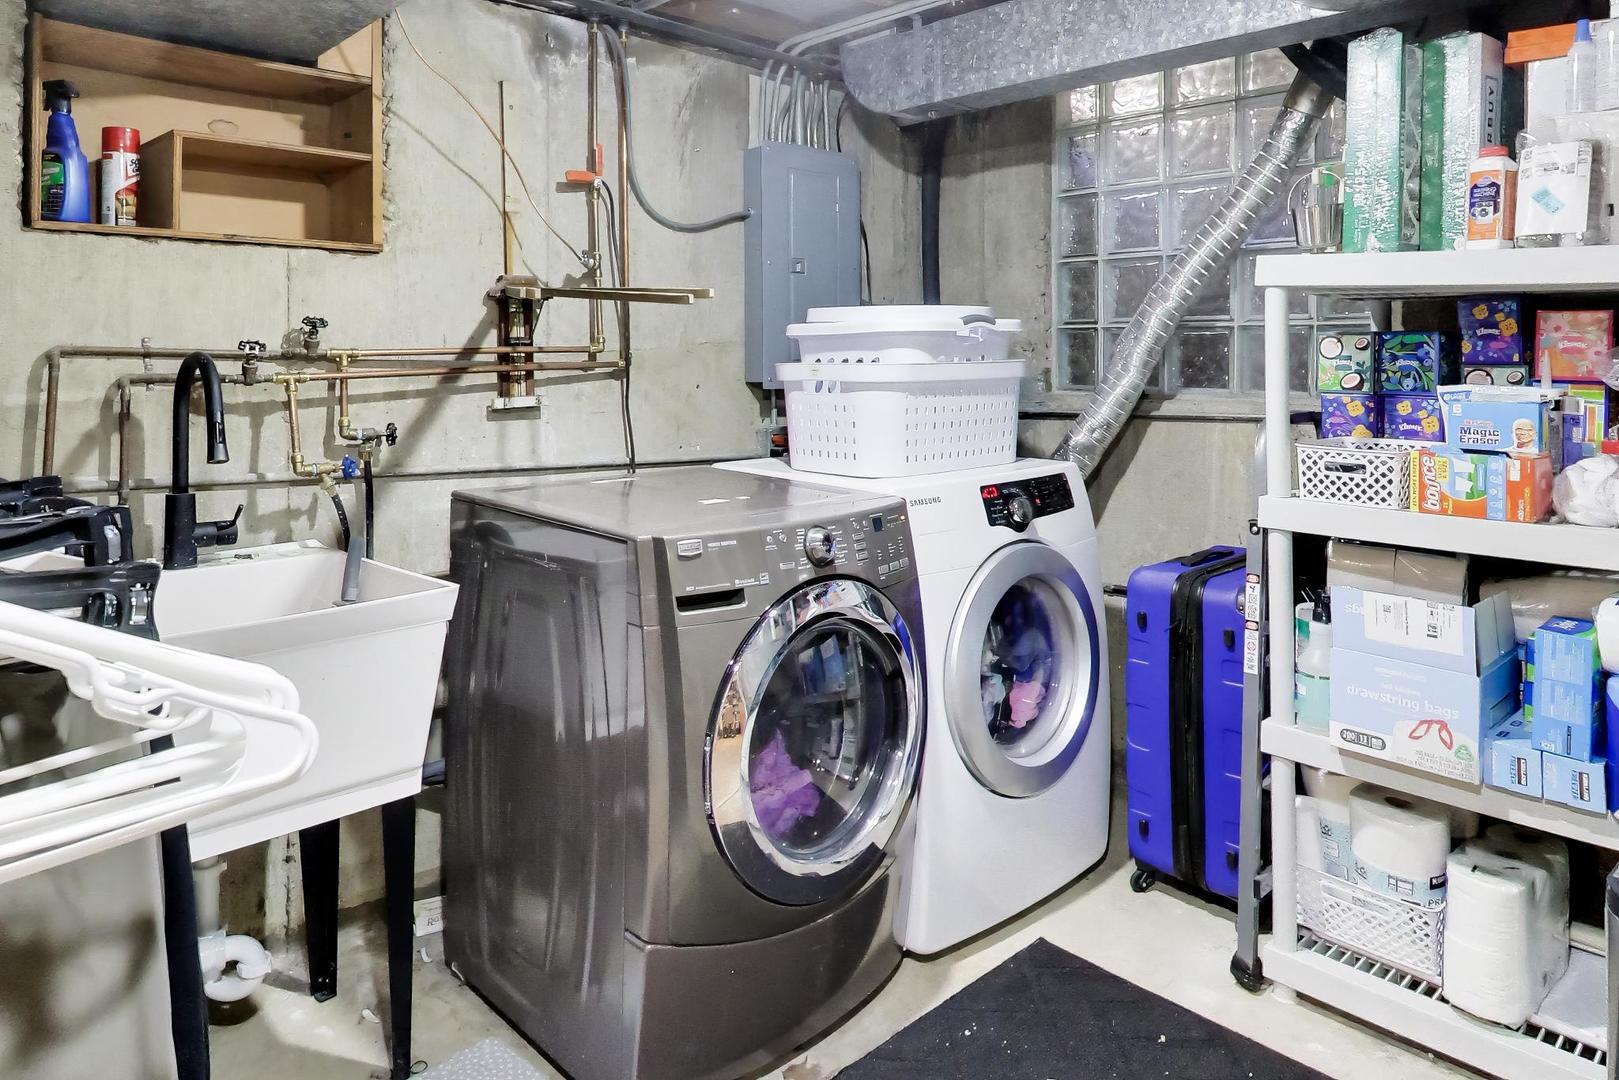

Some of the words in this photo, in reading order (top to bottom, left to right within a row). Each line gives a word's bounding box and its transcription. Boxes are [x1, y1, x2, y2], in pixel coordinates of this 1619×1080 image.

[1460, 426, 1500, 438] Magic
[1460, 435, 1500, 445] Eraser
[1422, 455, 1441, 511] bounce
[910, 496, 942, 507] SAMSUNG
[1346, 684, 1420, 712] drawstring
[1424, 699, 1460, 720] bags
